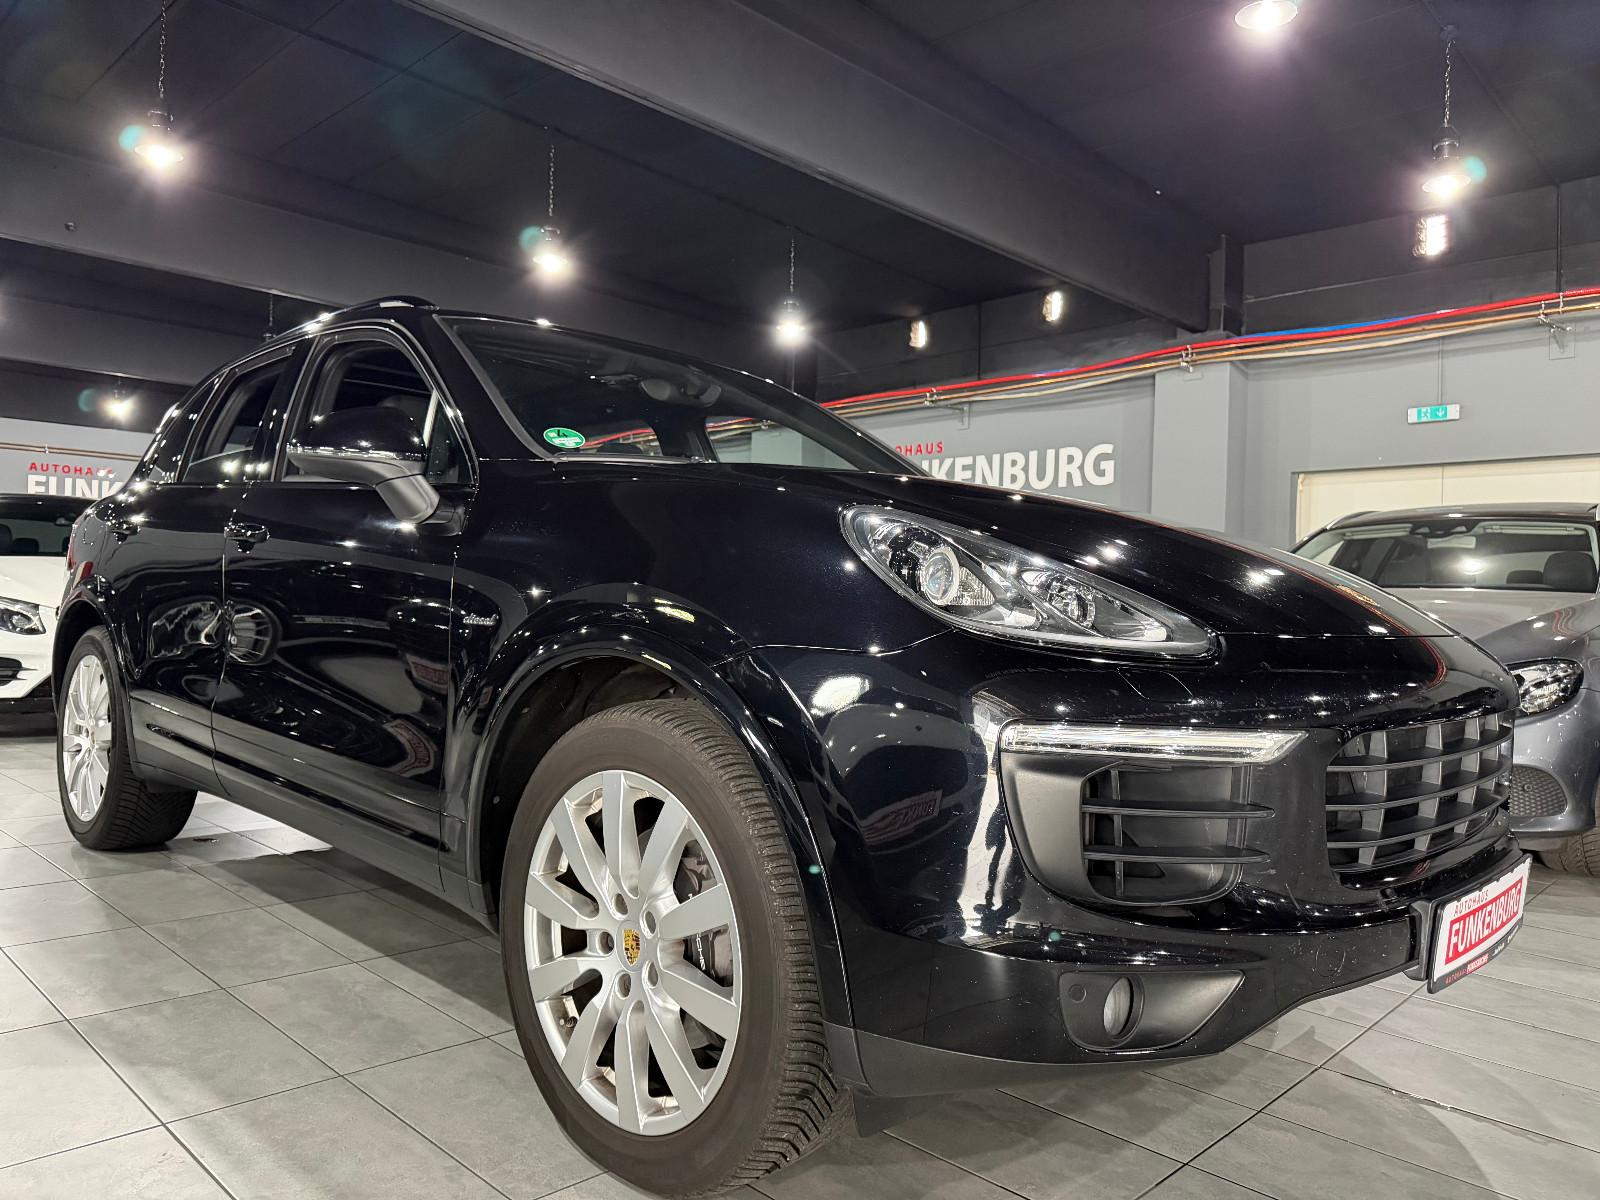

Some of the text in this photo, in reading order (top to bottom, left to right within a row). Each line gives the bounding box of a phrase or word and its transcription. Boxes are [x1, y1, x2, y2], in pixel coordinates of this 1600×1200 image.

[463, 613, 497, 626] diesel
[1454, 890, 1489, 917] AUTOHAUS
[1449, 882, 1521, 958] FUNKENBURG
